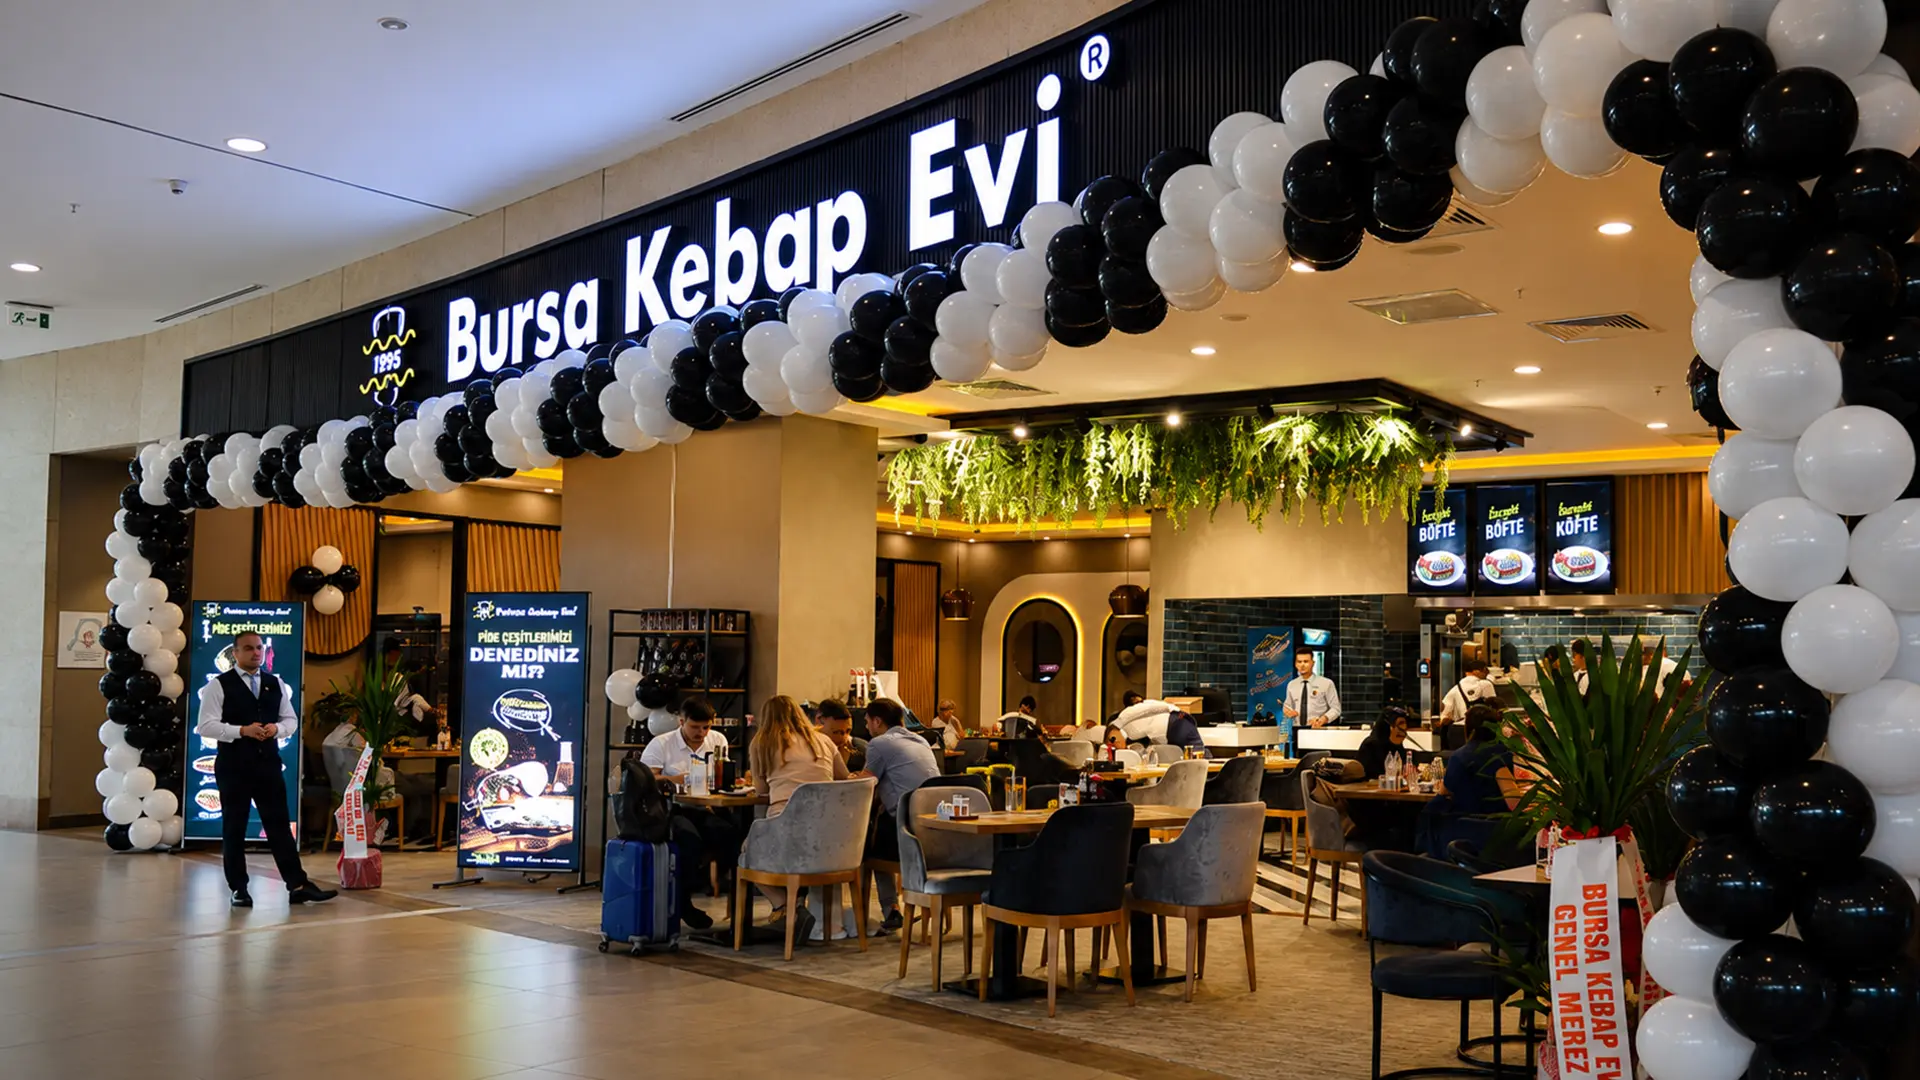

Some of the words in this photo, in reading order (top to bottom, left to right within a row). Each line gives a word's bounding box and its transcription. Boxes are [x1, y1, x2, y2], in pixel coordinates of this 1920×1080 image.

[447, 278, 599, 382] Bursa
[625, 191, 867, 334] Kebap
[909, 73, 1062, 252] Evi
[373, 348, 402, 375] 1995
[1555, 514, 1599, 538] KÖFTE
[469, 645, 580, 663] DENEDİNİZ
[477, 629, 500, 644] PİDE
[1554, 904, 1579, 981] GENEL
[1582, 883, 1611, 965] BURSA
[1557, 992, 1591, 1074] MEREZ
[1586, 972, 1619, 1049] KEBAP
